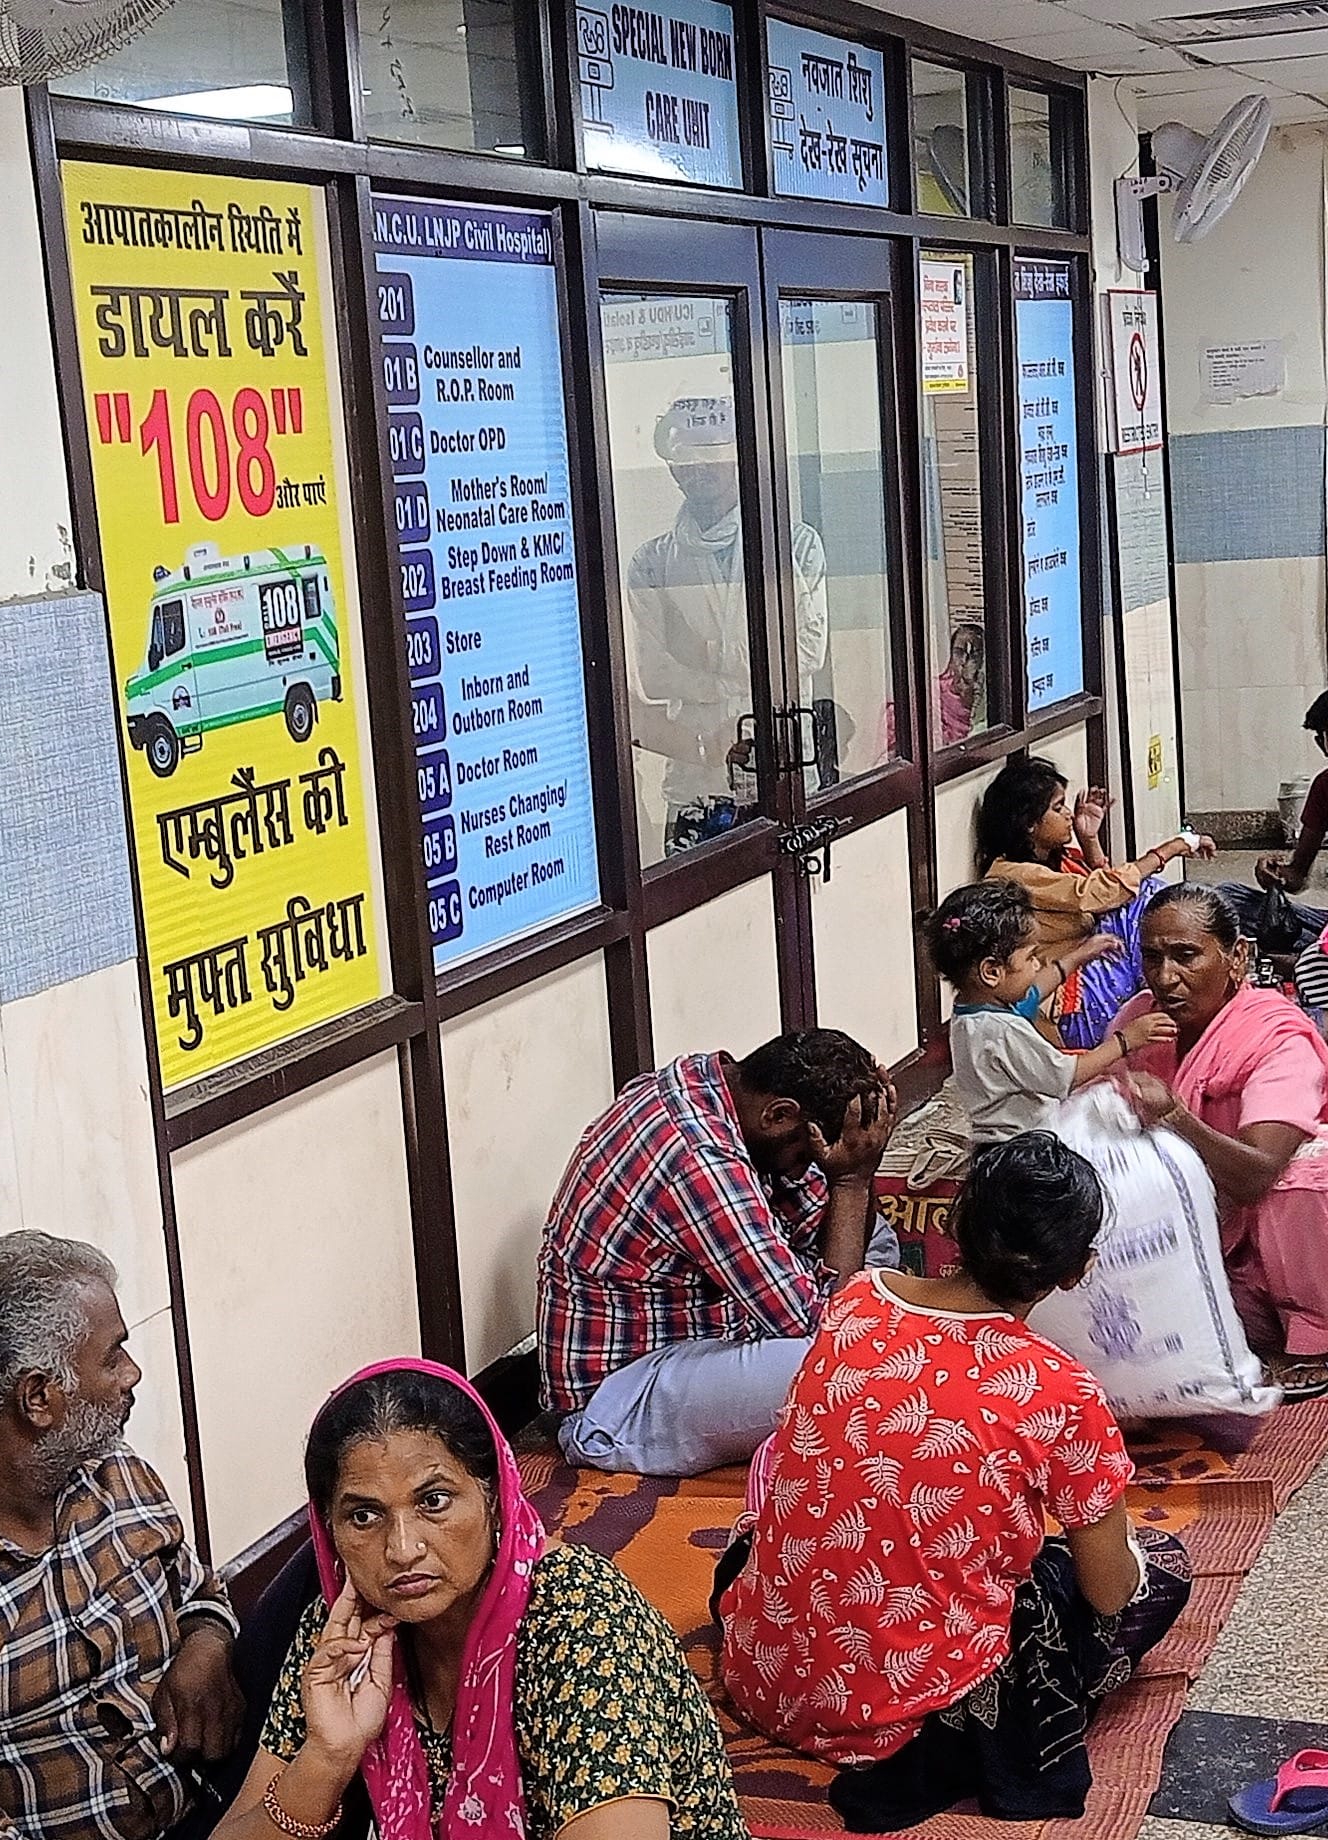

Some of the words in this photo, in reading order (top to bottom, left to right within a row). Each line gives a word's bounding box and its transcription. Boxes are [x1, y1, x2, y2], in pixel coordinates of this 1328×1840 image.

[611, 4, 667, 65] SPECIAL
[670, 18, 697, 72] NEW
[700, 27, 733, 81] BORN
[801, 53, 844, 100] नवजात
[847, 51, 874, 122] शिशु
[646, 91, 679, 143] CARE
[683, 99, 710, 149] UNIT
[799, 114, 847, 174] देख-रेख
[850, 139, 883, 192] सूचना
[80, 199, 224, 252] आपातकालीन
[228, 203, 283, 255] स्थिति
[286, 207, 302, 256] में
[424, 216, 460, 248] LNJP
[465, 220, 493, 251] Civil
[496, 223, 552, 262] Hospital)
[91, 284, 229, 358] डायल
[240, 271, 308, 357] करें
[378, 286, 405, 321] 201
[406, 357, 417, 390] B
[424, 345, 494, 369] Counsellor
[498, 346, 521, 368] and
[436, 378, 474, 402] R.O.P.
[478, 378, 514, 401] Room
[410, 427, 423, 460] C
[430, 430, 475, 453] Doctor
[479, 428, 505, 450] OPD
[276, 477, 300, 508] और
[303, 474, 326, 505] पाएं
[451, 476, 506, 502] Mother's
[511, 472, 548, 496] Room/
[417, 496, 428, 528] D
[436, 504, 495, 532] Neonatal
[499, 503, 528, 525] Care
[532, 500, 565, 521] Room
[448, 546, 477, 572] Step
[482, 542, 516, 564] Down
[522, 537, 530, 558] &
[534, 532, 564, 558] KMC/
[401, 564, 427, 598] 202
[442, 572, 486, 599] Breast
[489, 565, 537, 591] Feeding
[541, 562, 573, 584] Room
[263, 585, 299, 629] 108
[406, 631, 432, 666] 203
[446, 631, 481, 654] Store
[462, 675, 503, 700] Inborn
[507, 664, 529, 690] and
[412, 697, 437, 734] 204
[453, 708, 504, 735] Outborn
[508, 698, 542, 722] Room
[439, 763, 450, 796] A
[457, 756, 500, 784] Doctor
[503, 747, 538, 771] Room
[299, 747, 349, 835] की
[461, 804, 506, 834] Nurses
[510, 779, 567, 817] Changing/
[444, 828, 455, 860] B
[485, 829, 513, 858] Rest
[517, 821, 551, 848] Room
[469, 872, 528, 909] Computer
[532, 858, 564, 886] Room
[450, 893, 460, 924] C
[163, 935, 252, 1051] मुफ्त
[257, 896, 367, 1011] सुविधा
